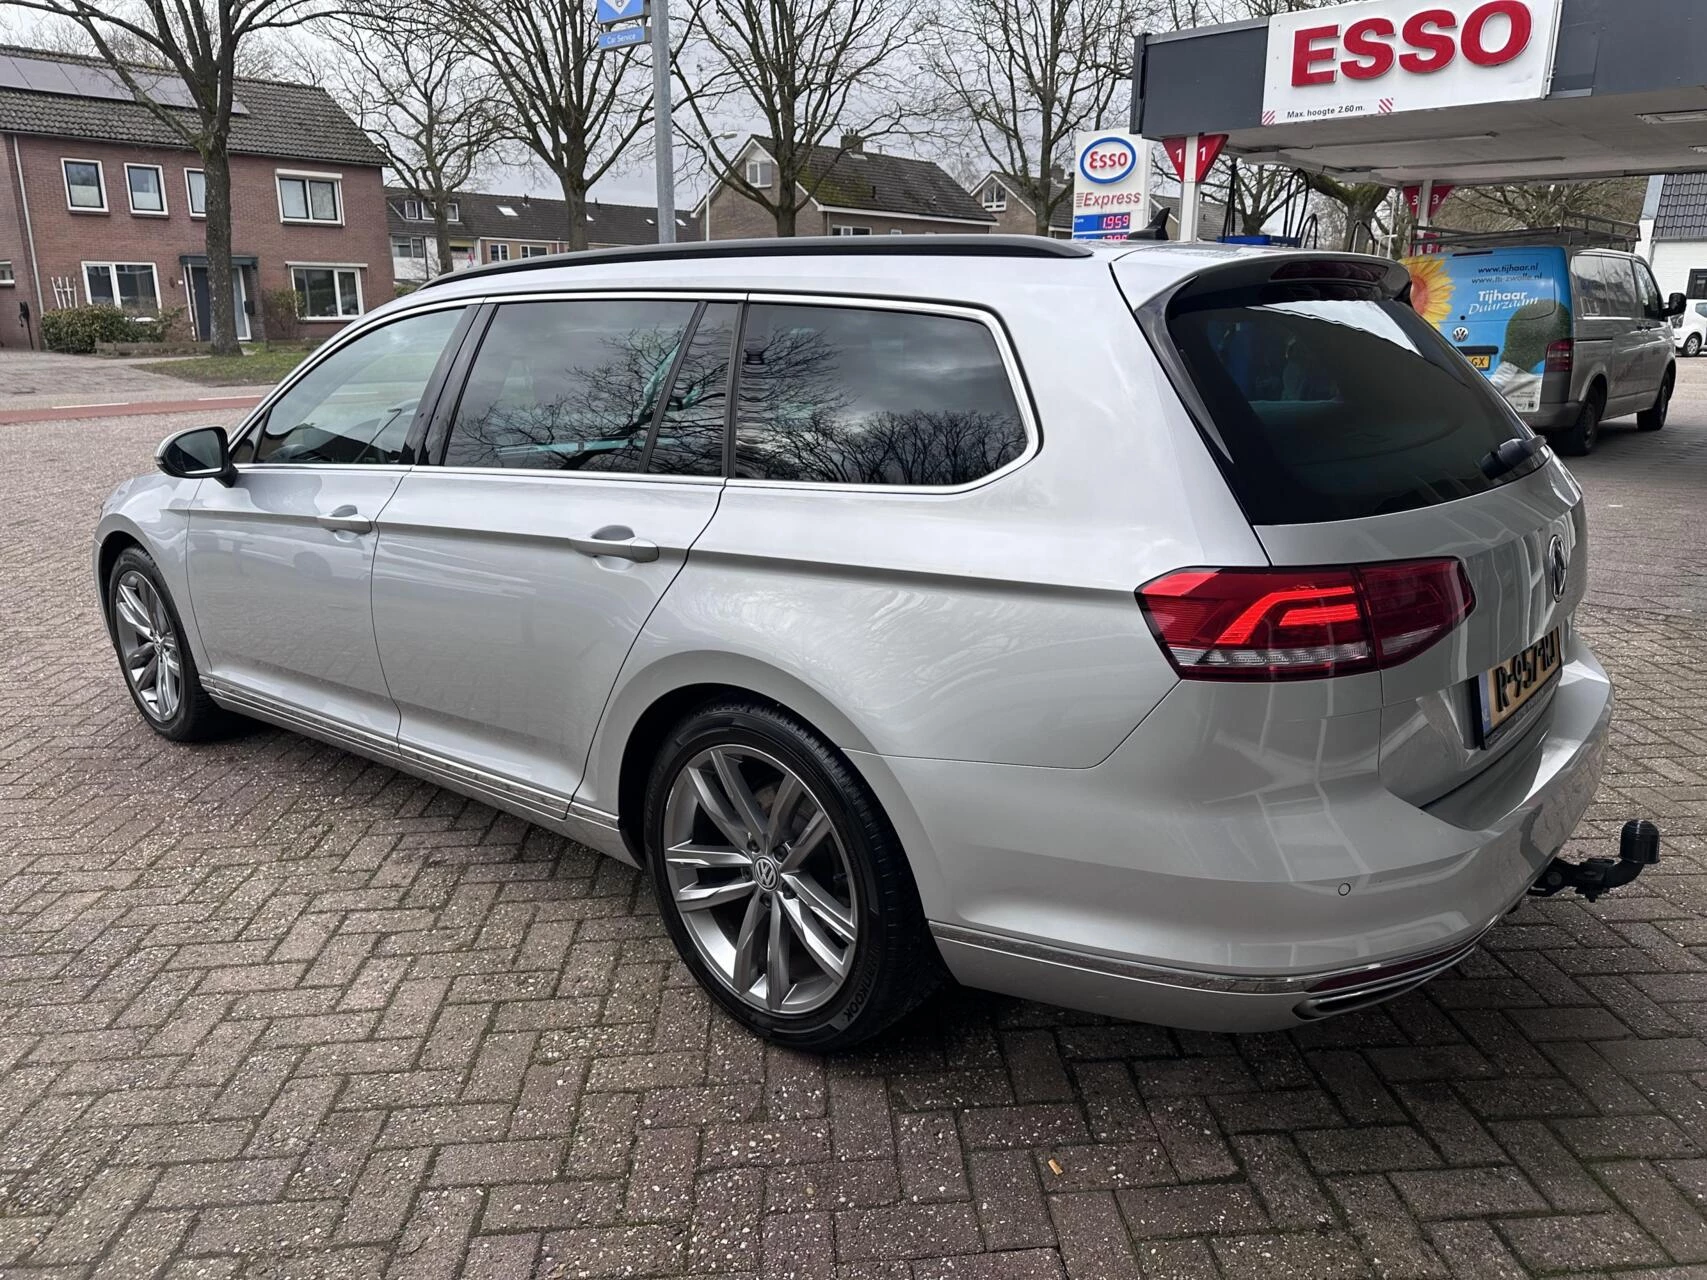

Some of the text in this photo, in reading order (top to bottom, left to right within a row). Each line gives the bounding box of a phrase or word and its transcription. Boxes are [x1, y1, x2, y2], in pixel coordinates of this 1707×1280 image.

[1291, 0, 1532, 87] ESSO
[1286, 109, 1305, 119] Max.
[1307, 107, 1335, 119] hoogte
[1337, 104, 1354, 114] 2.60
[1089, 151, 1128, 169] Esso
[1175, 148, 1182, 163] 1
[1199, 146, 1206, 161] 1
[1083, 192, 1142, 209] Express
[1478, 262, 1539, 273] www.tijhaar.nl
[1478, 289, 1528, 304] Tijhaar
[1468, 297, 1539, 314] Duurzaam
